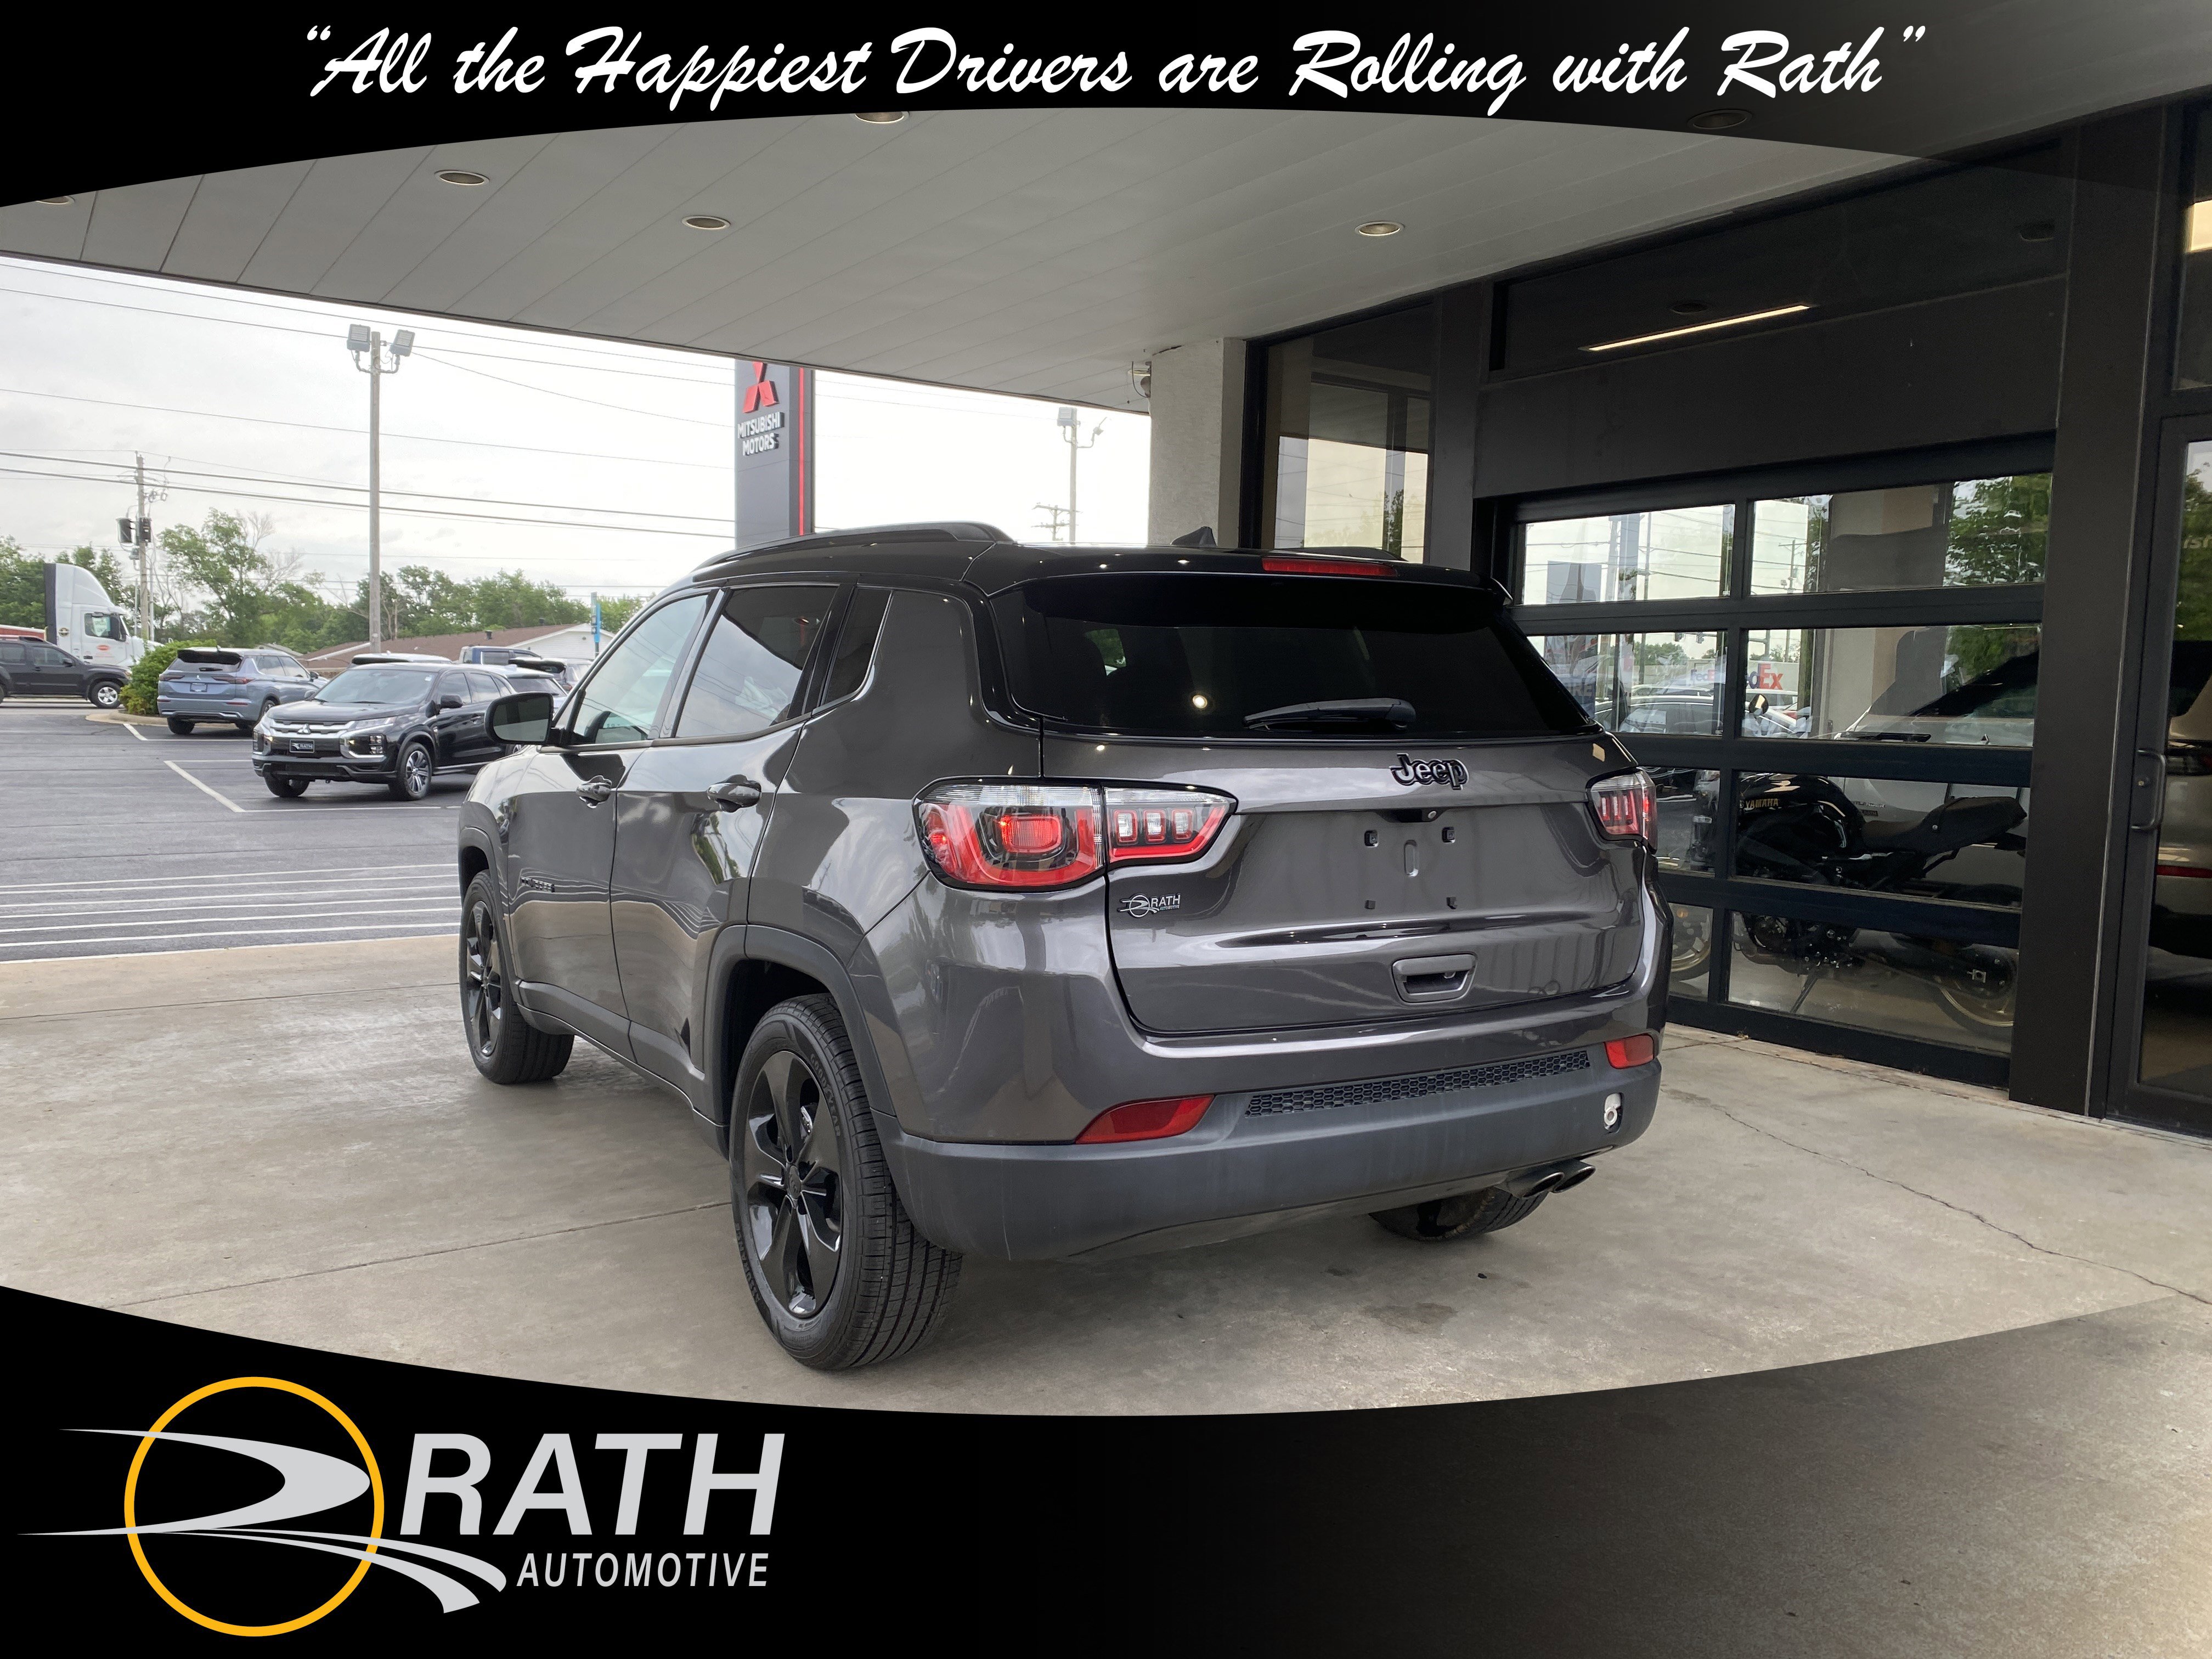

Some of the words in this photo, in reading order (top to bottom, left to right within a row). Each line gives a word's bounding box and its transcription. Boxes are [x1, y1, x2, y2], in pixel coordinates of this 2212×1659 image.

[737, 411, 782, 438] MITSUBISHI
[742, 432, 776, 456] MOTORS
[1690, 669, 1715, 681] FedE
[1745, 663, 1784, 690] dEx
[1389, 753, 1470, 790] Jeep
[1745, 798, 1779, 809] YAMAHA
[1150, 894, 1181, 907] RATH
